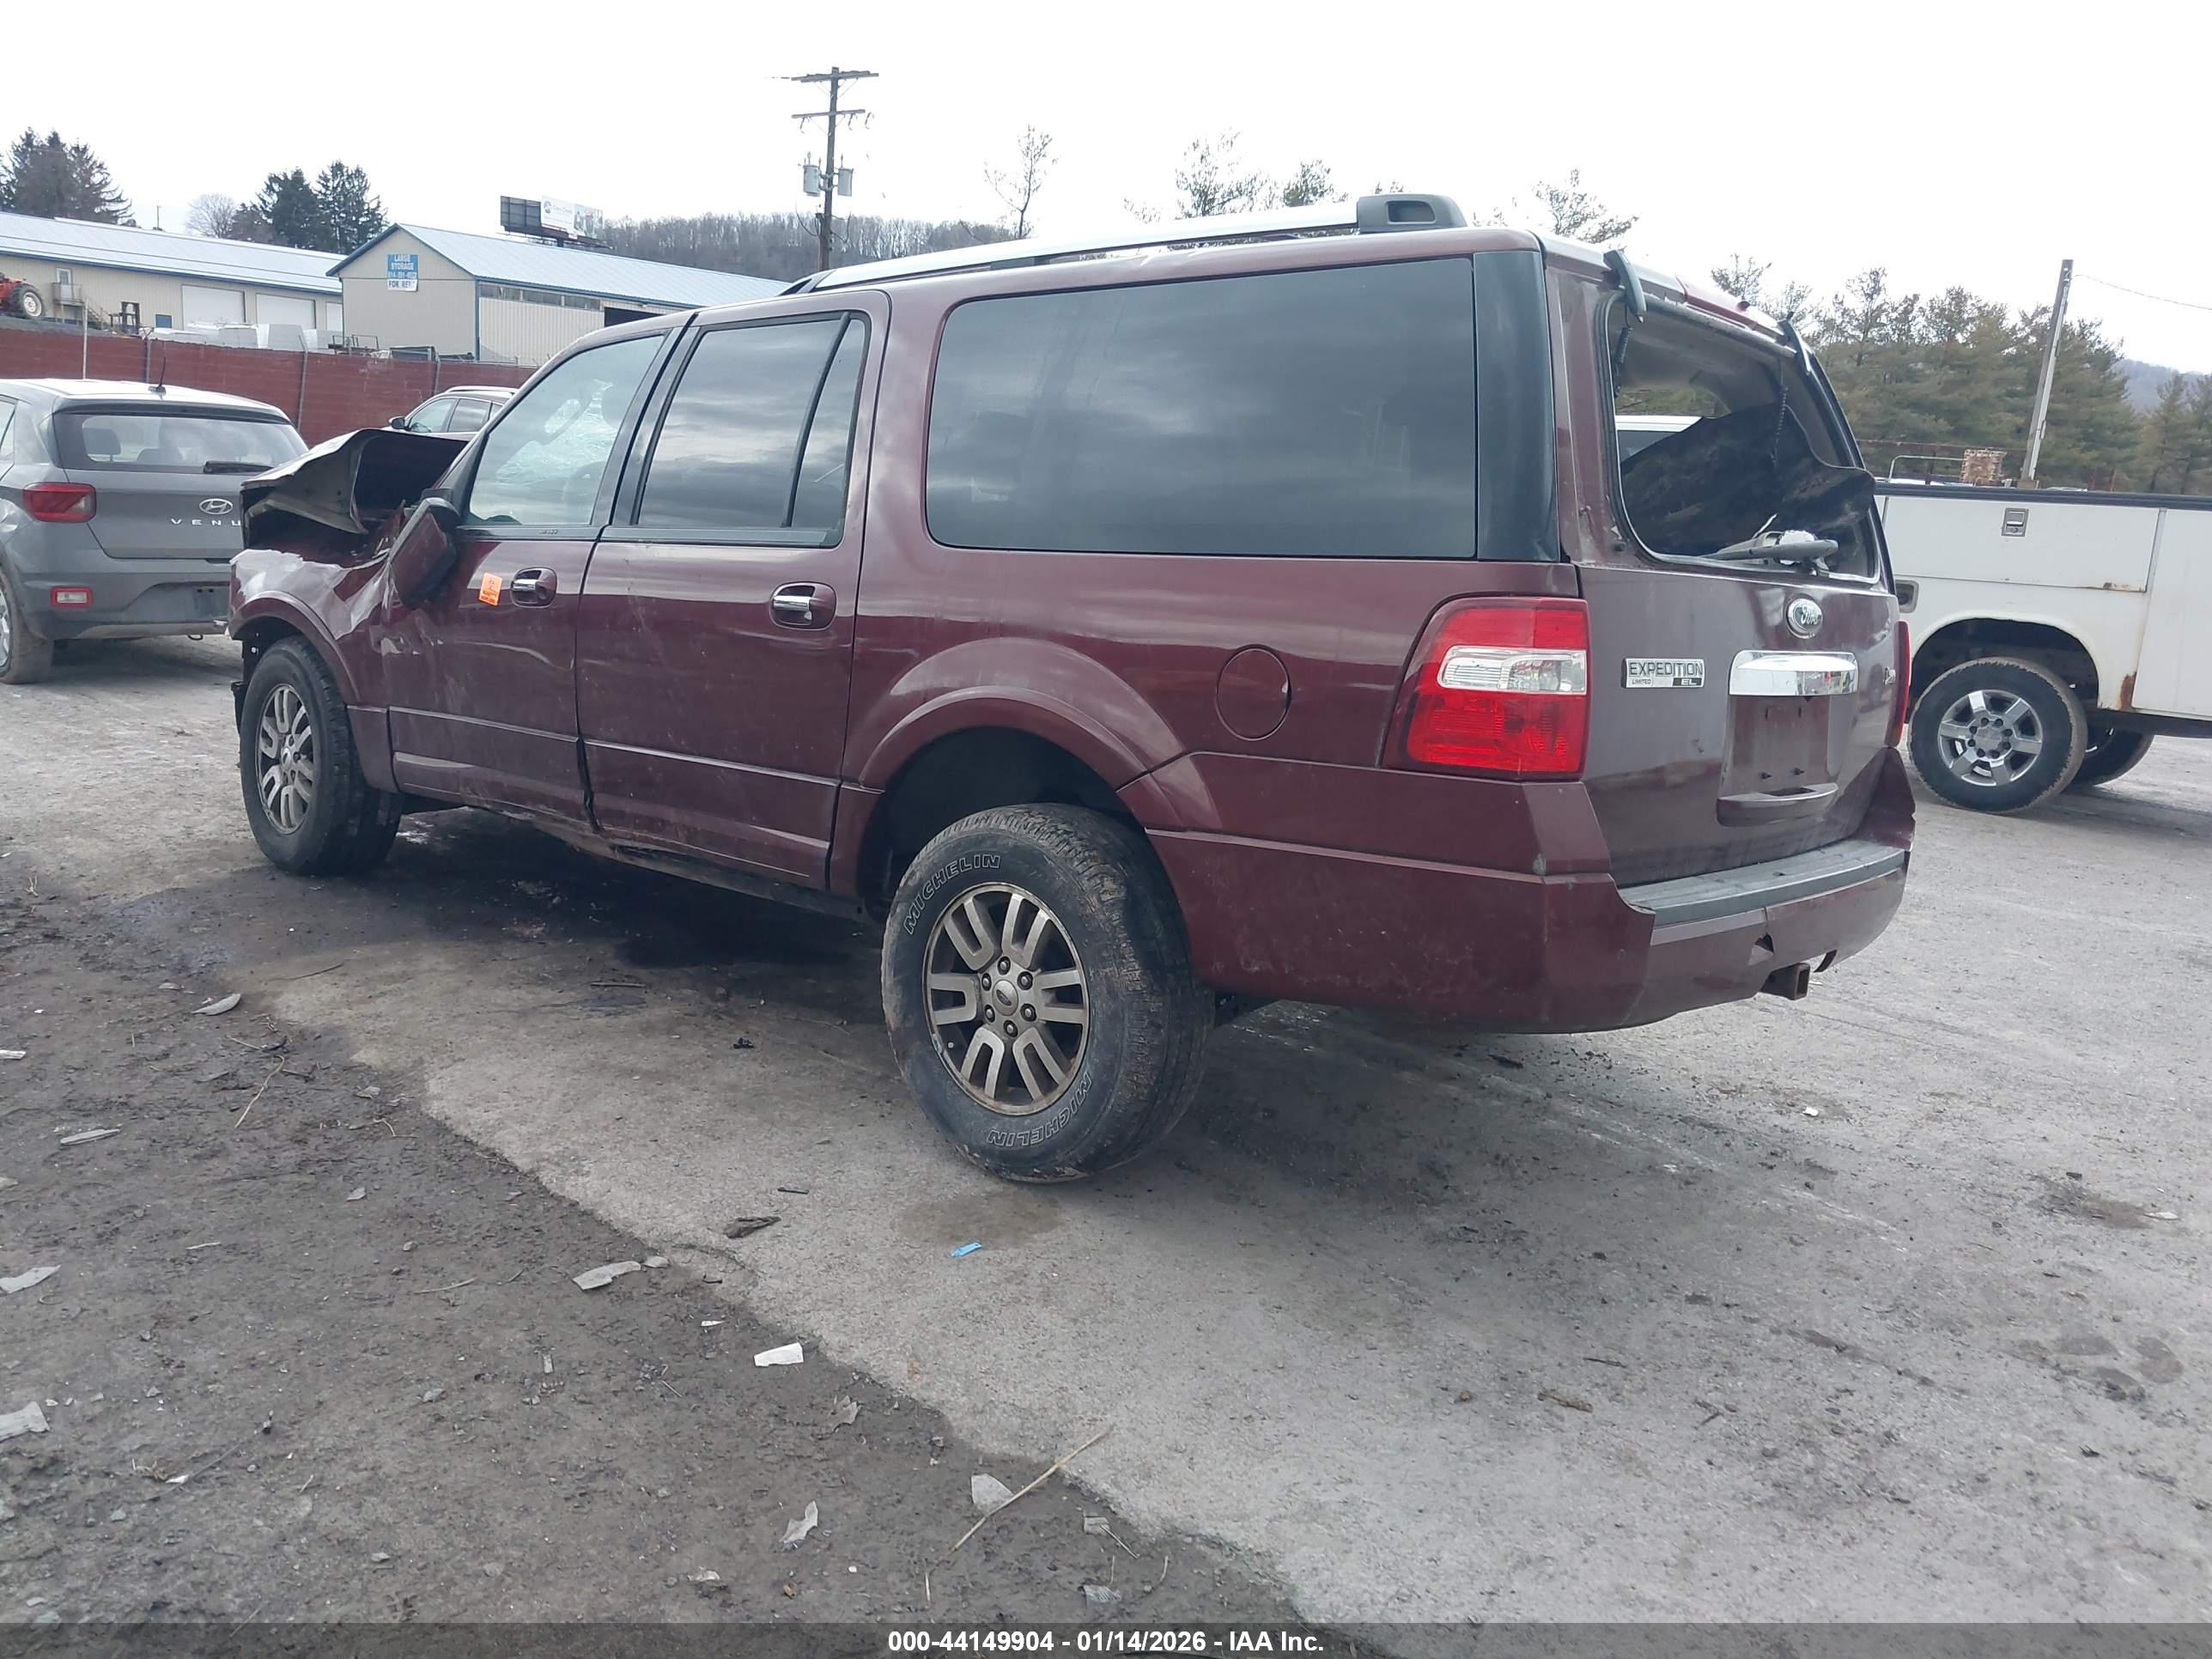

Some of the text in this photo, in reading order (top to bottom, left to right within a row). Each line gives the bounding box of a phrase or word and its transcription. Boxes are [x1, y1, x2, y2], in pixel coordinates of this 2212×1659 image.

[1629, 662, 1703, 677] EXPEDITION
[903, 854, 1000, 934] MICHELIN
[986, 1071, 1091, 1146] MICHELIN
